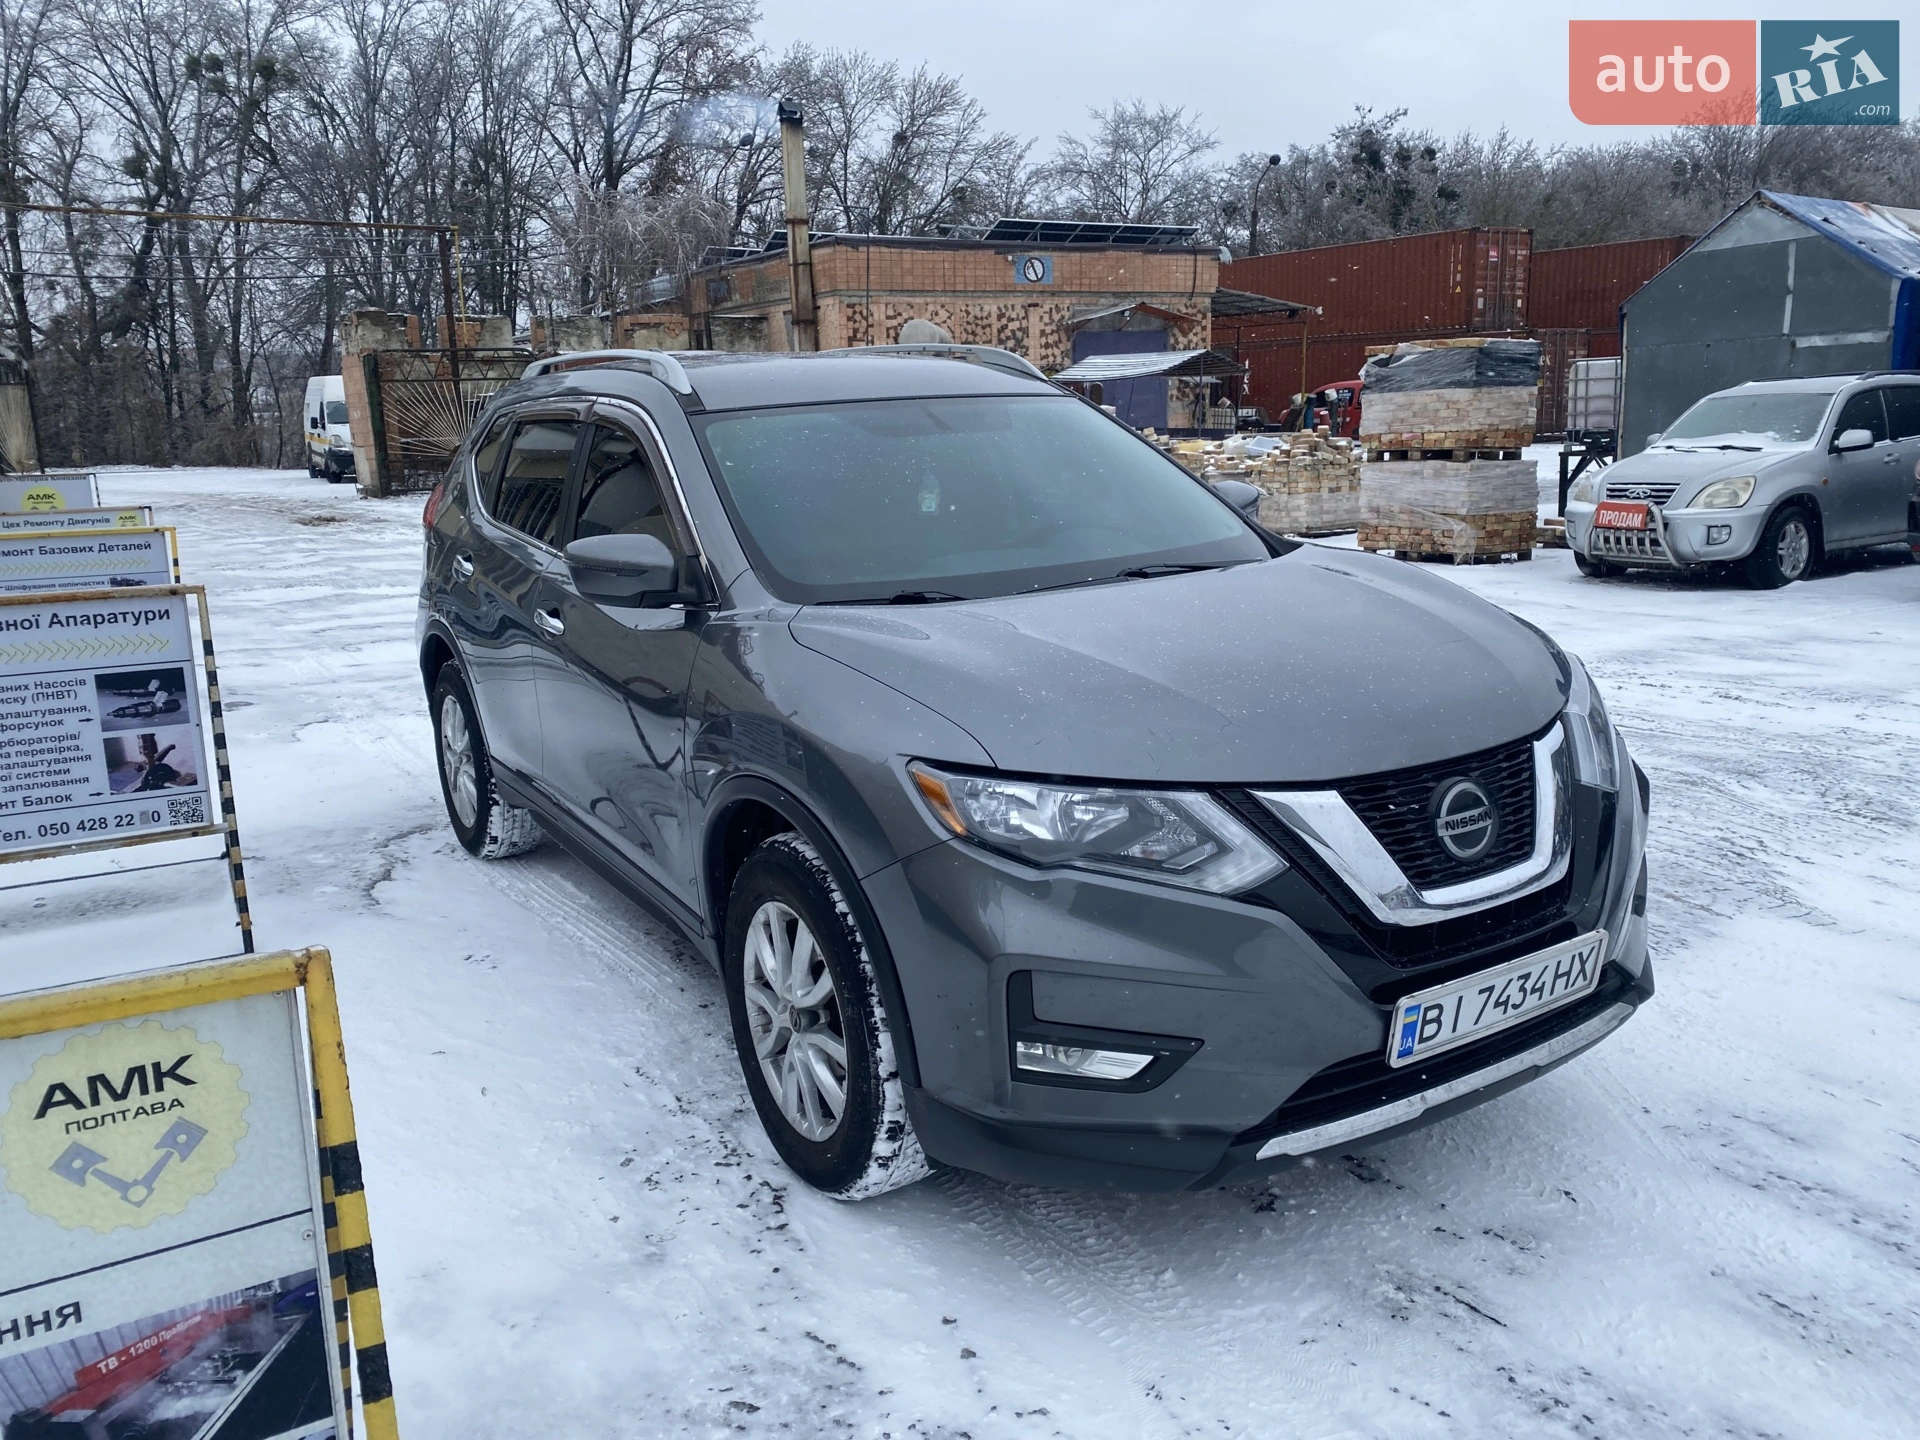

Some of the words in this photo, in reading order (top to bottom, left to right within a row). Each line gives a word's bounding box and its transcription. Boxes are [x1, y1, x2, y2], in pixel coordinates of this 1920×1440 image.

[27, 493, 56, 501] АМК
[2, 521, 21, 529] Цех
[23, 518, 64, 528] Ремонту
[67, 516, 111, 527] Двигунів
[1598, 510, 1643, 527] ПРОДАМ
[0, 548, 34, 557] монт
[38, 545, 94, 556] Базових
[98, 541, 152, 553] Деталей
[4, 583, 56, 592] Шліфування
[0, 614, 41, 632] ної
[48, 608, 171, 629] Апаратури
[34, 677, 87, 690] Насосів
[31, 688, 78, 705] (ПНВТ)
[15, 743, 84, 758] перевірка,
[16, 767, 71, 780] системи
[1, 776, 90, 793] запалювання
[22, 793, 73, 807] Балок
[0, 829, 32, 843] ел.
[37, 821, 71, 838] 050
[76, 816, 109, 832] 428
[113, 813, 136, 828] 22
[1444, 809, 1493, 832] NISSAN
[1417, 995, 1464, 1045] BI
[1473, 964, 1549, 1027] 7434
[1549, 946, 1597, 997] HX
[1399, 1035, 1413, 1051] UA
[33, 1053, 198, 1121] АМК
[65, 1098, 186, 1136] ПОЛТАВА
[129, 1337, 158, 1357] 1200
